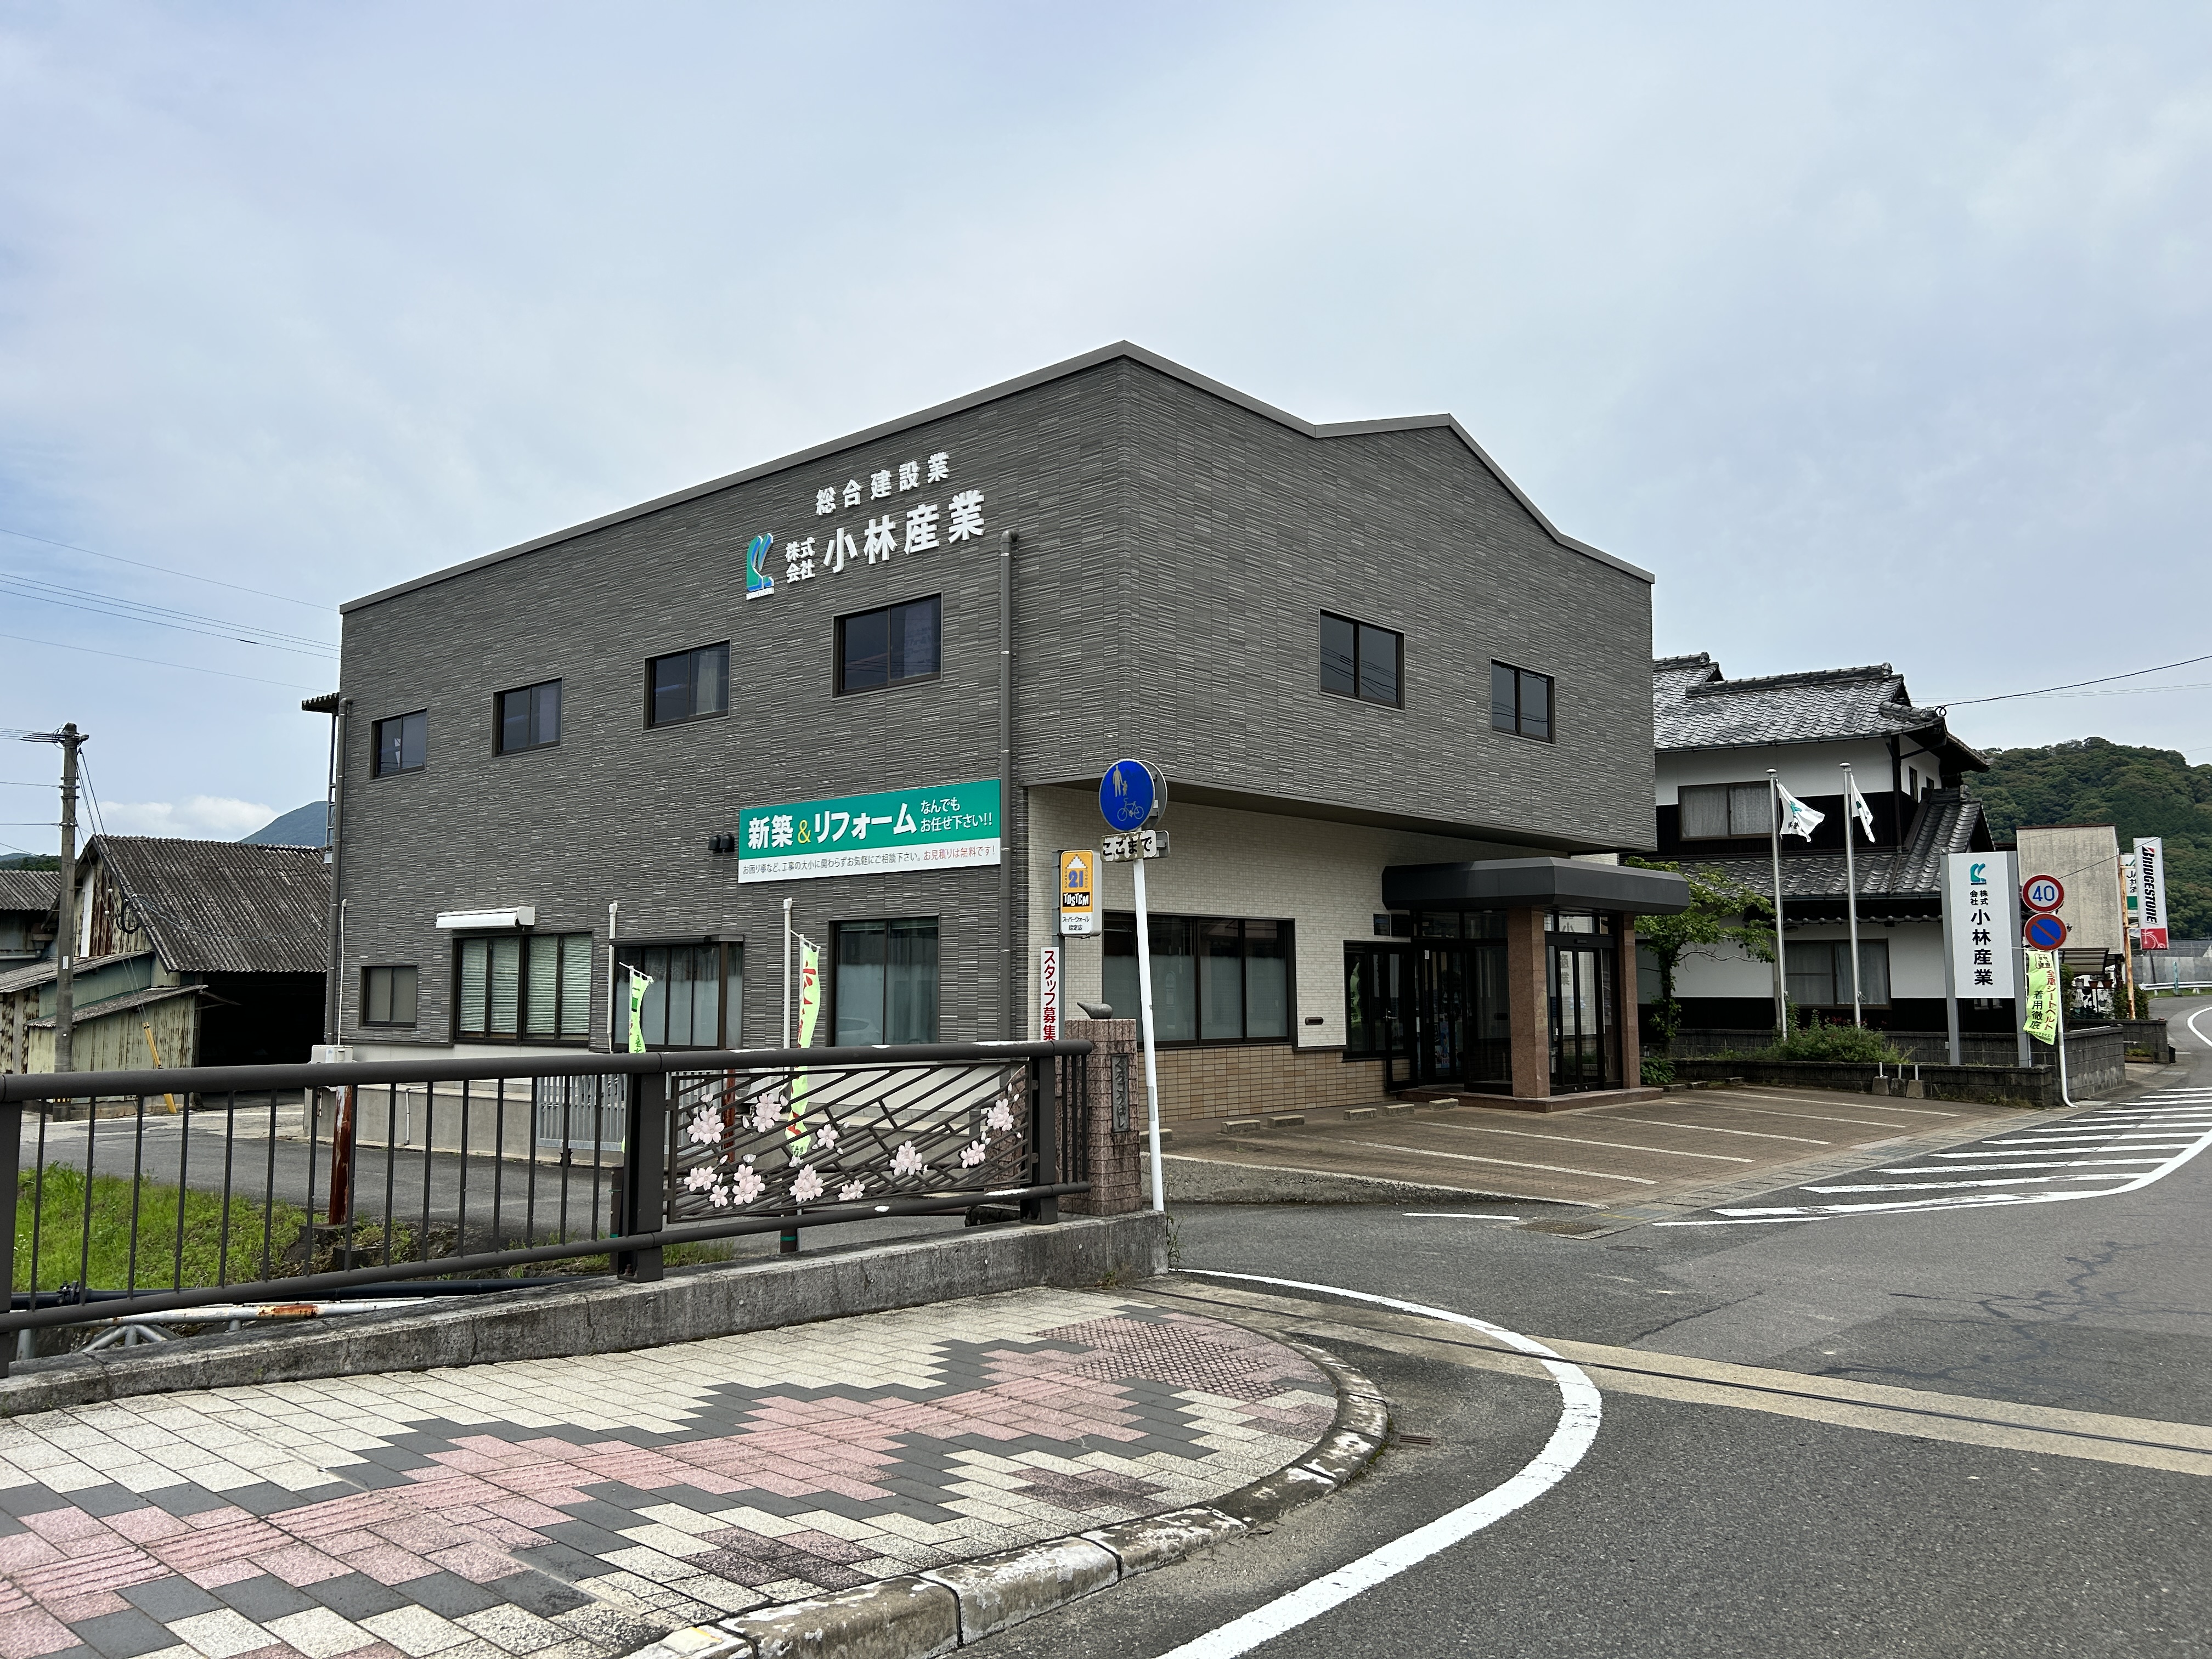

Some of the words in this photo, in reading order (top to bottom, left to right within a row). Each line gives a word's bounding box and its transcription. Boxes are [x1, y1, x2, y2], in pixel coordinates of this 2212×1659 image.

[816, 452, 950, 516] 総合建設業
[823, 489, 985, 574] 小林産業
[785, 537, 816, 562] 株式
[786, 559, 816, 584] 会社
[921, 797, 961, 814] なんでも
[1103, 837, 1153, 856] ここまで
[1068, 870, 1084, 888] 21
[2142, 846, 2157, 923] BRIDGESTONE
[1063, 893, 1089, 906] TOSTEM
[2032, 885, 2055, 902] 40
[1971, 909, 1993, 985] 小林産業
[1043, 951, 1056, 1041] スタッフ募集
[2029, 991, 2044, 1030] 着用徹底
